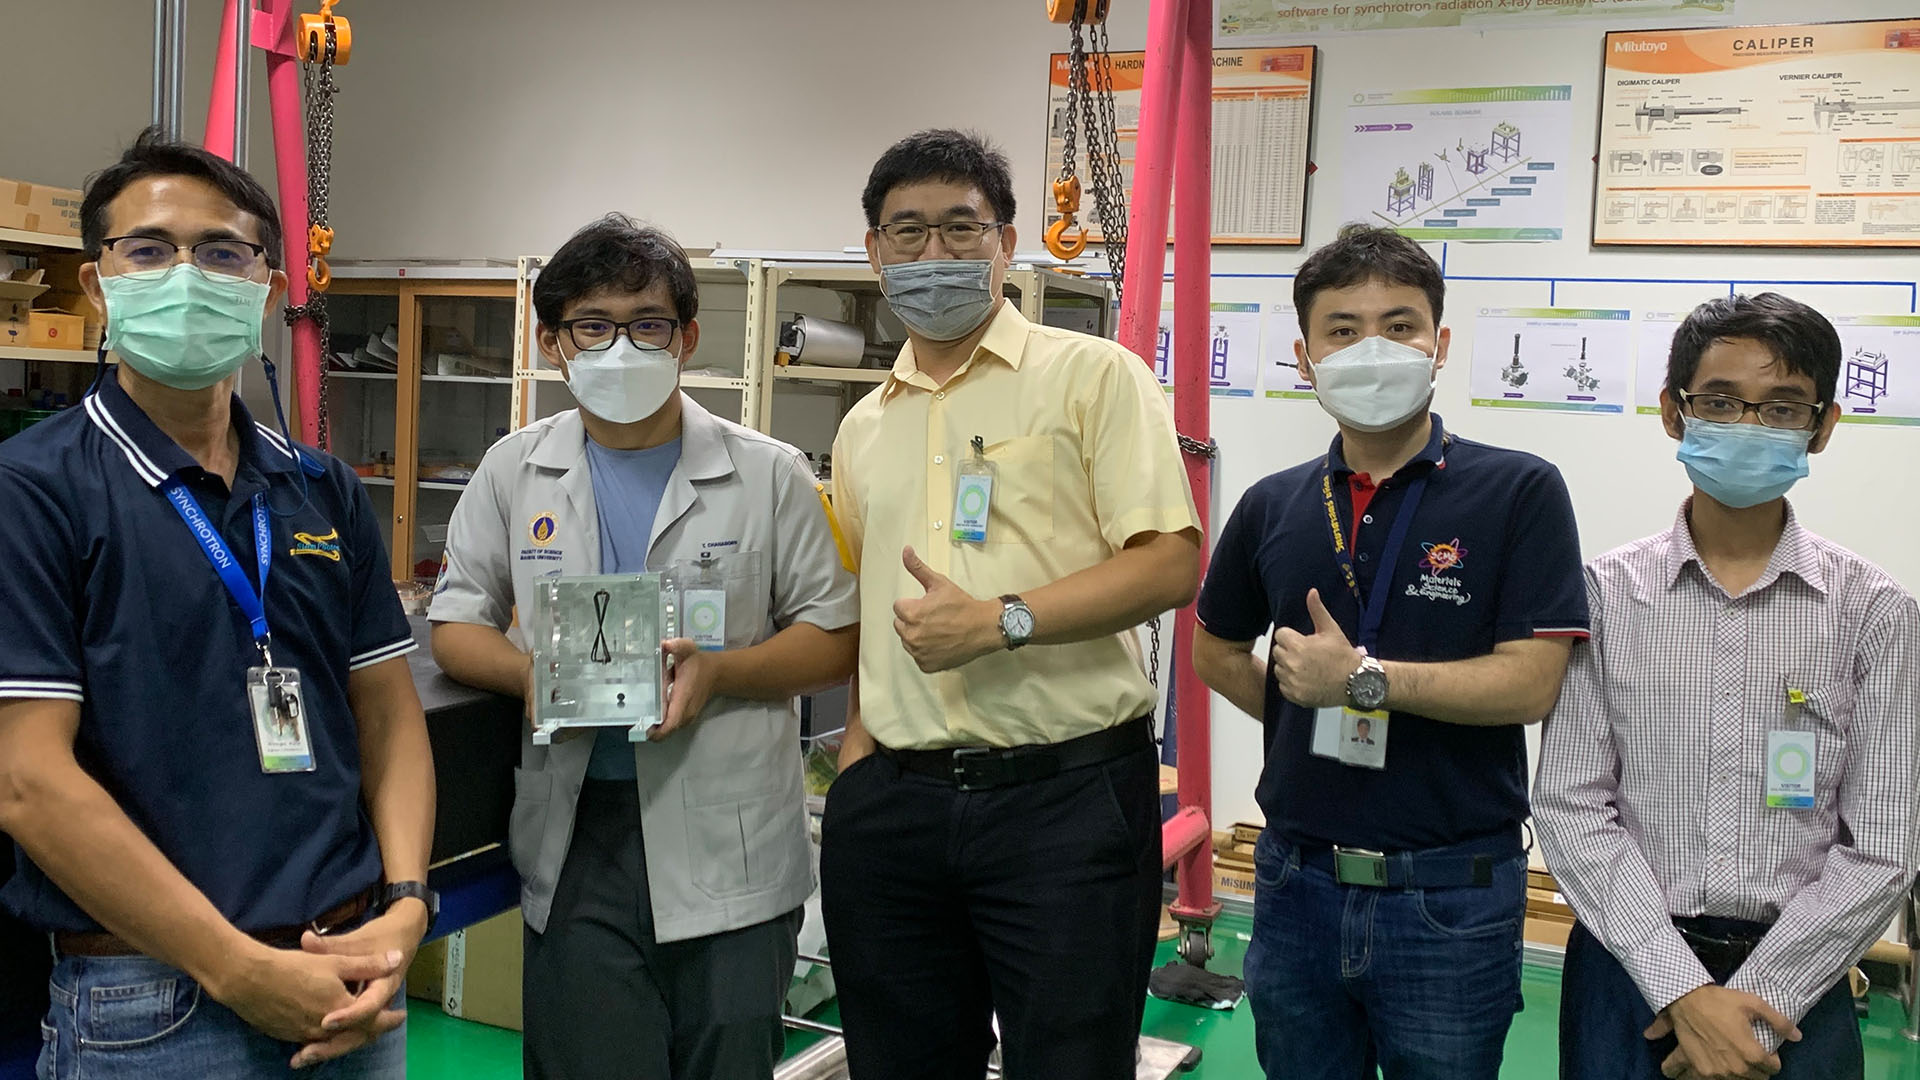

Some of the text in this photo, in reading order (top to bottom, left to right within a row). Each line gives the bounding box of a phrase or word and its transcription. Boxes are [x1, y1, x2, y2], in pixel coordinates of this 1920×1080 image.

[1277, 7, 1329, 18] software
[1333, 4, 1351, 15] for
[1354, 2, 1431, 16] synchrotron
[1435, 0, 1493, 10] radiation
[1614, 40, 1668, 55] Mitutoyo
[1732, 36, 1815, 51] CALIPER
[1115, 57, 1243, 70] HARDN ACHINE
[170, 486, 232, 569] SYNCHROTRON
[255, 489, 269, 566] SYNCHROTRO
[1420, 574, 1462, 587] Materials
[1405, 584, 1471, 606] & Engineering
[1221, 876, 1255, 891] MiSUM
